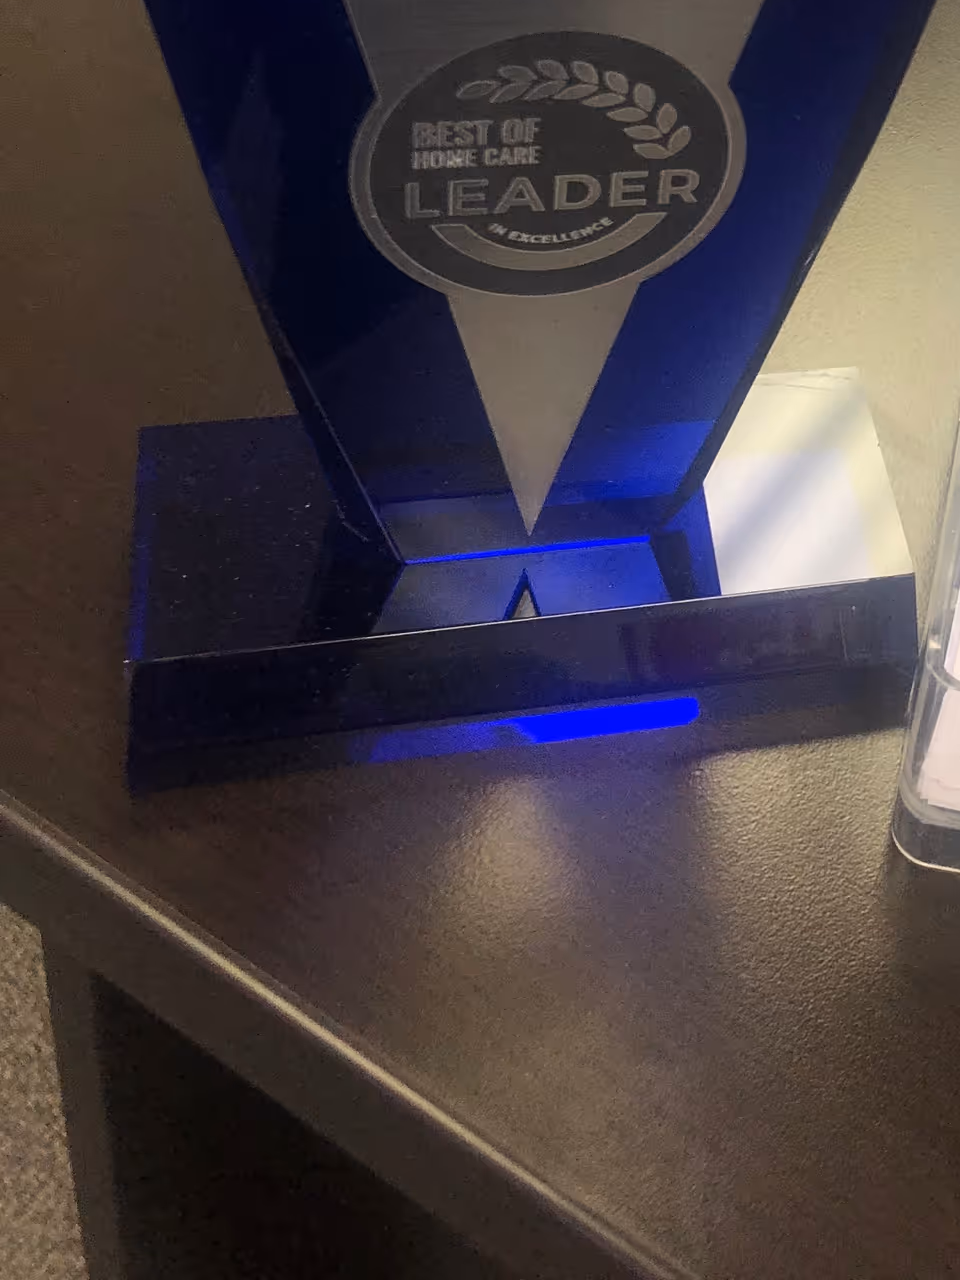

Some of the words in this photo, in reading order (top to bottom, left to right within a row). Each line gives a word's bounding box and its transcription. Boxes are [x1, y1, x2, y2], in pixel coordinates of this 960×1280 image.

[412, 120, 493, 148] BEST
[501, 117, 541, 144] OF
[411, 148, 478, 169] HOME
[484, 146, 541, 166] CARE
[404, 169, 700, 219] LEADER
[508, 217, 614, 243] EXCELLENCE
